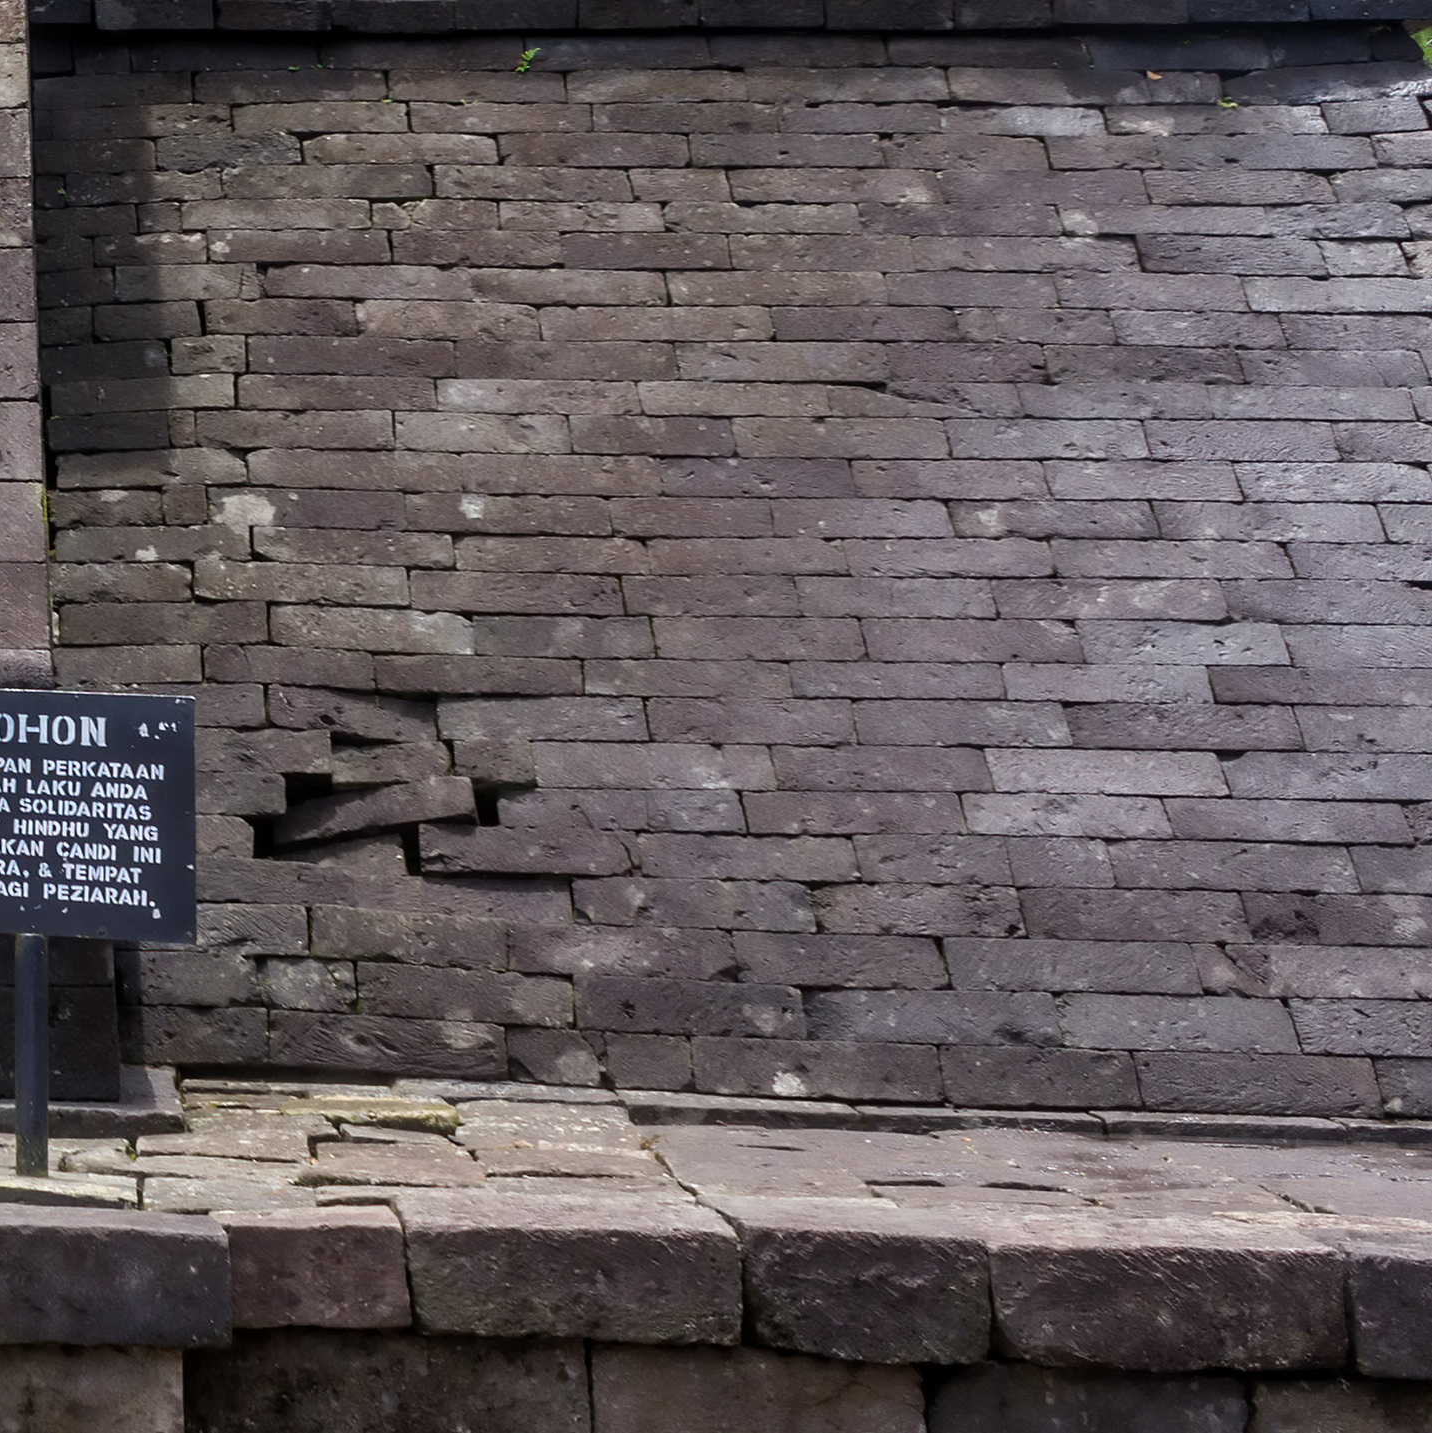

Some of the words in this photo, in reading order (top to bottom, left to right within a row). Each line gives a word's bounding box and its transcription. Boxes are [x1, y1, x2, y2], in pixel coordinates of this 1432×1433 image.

[43, 759, 164, 781] PERKATAAN
[27, 779, 81, 796] LAKU
[91, 782, 148, 800] ANDA
[20, 798, 151, 820] SOLIDARITAS
[14, 818, 89, 838] HINDHU
[103, 823, 158, 841] YANG
[57, 842, 116, 861] CANDI
[134, 846, 161, 864] INI
[39, 863, 52, 877] &
[62, 863, 142, 884] TEMPAT
[44, 883, 155, 907] PEZIARAH.
